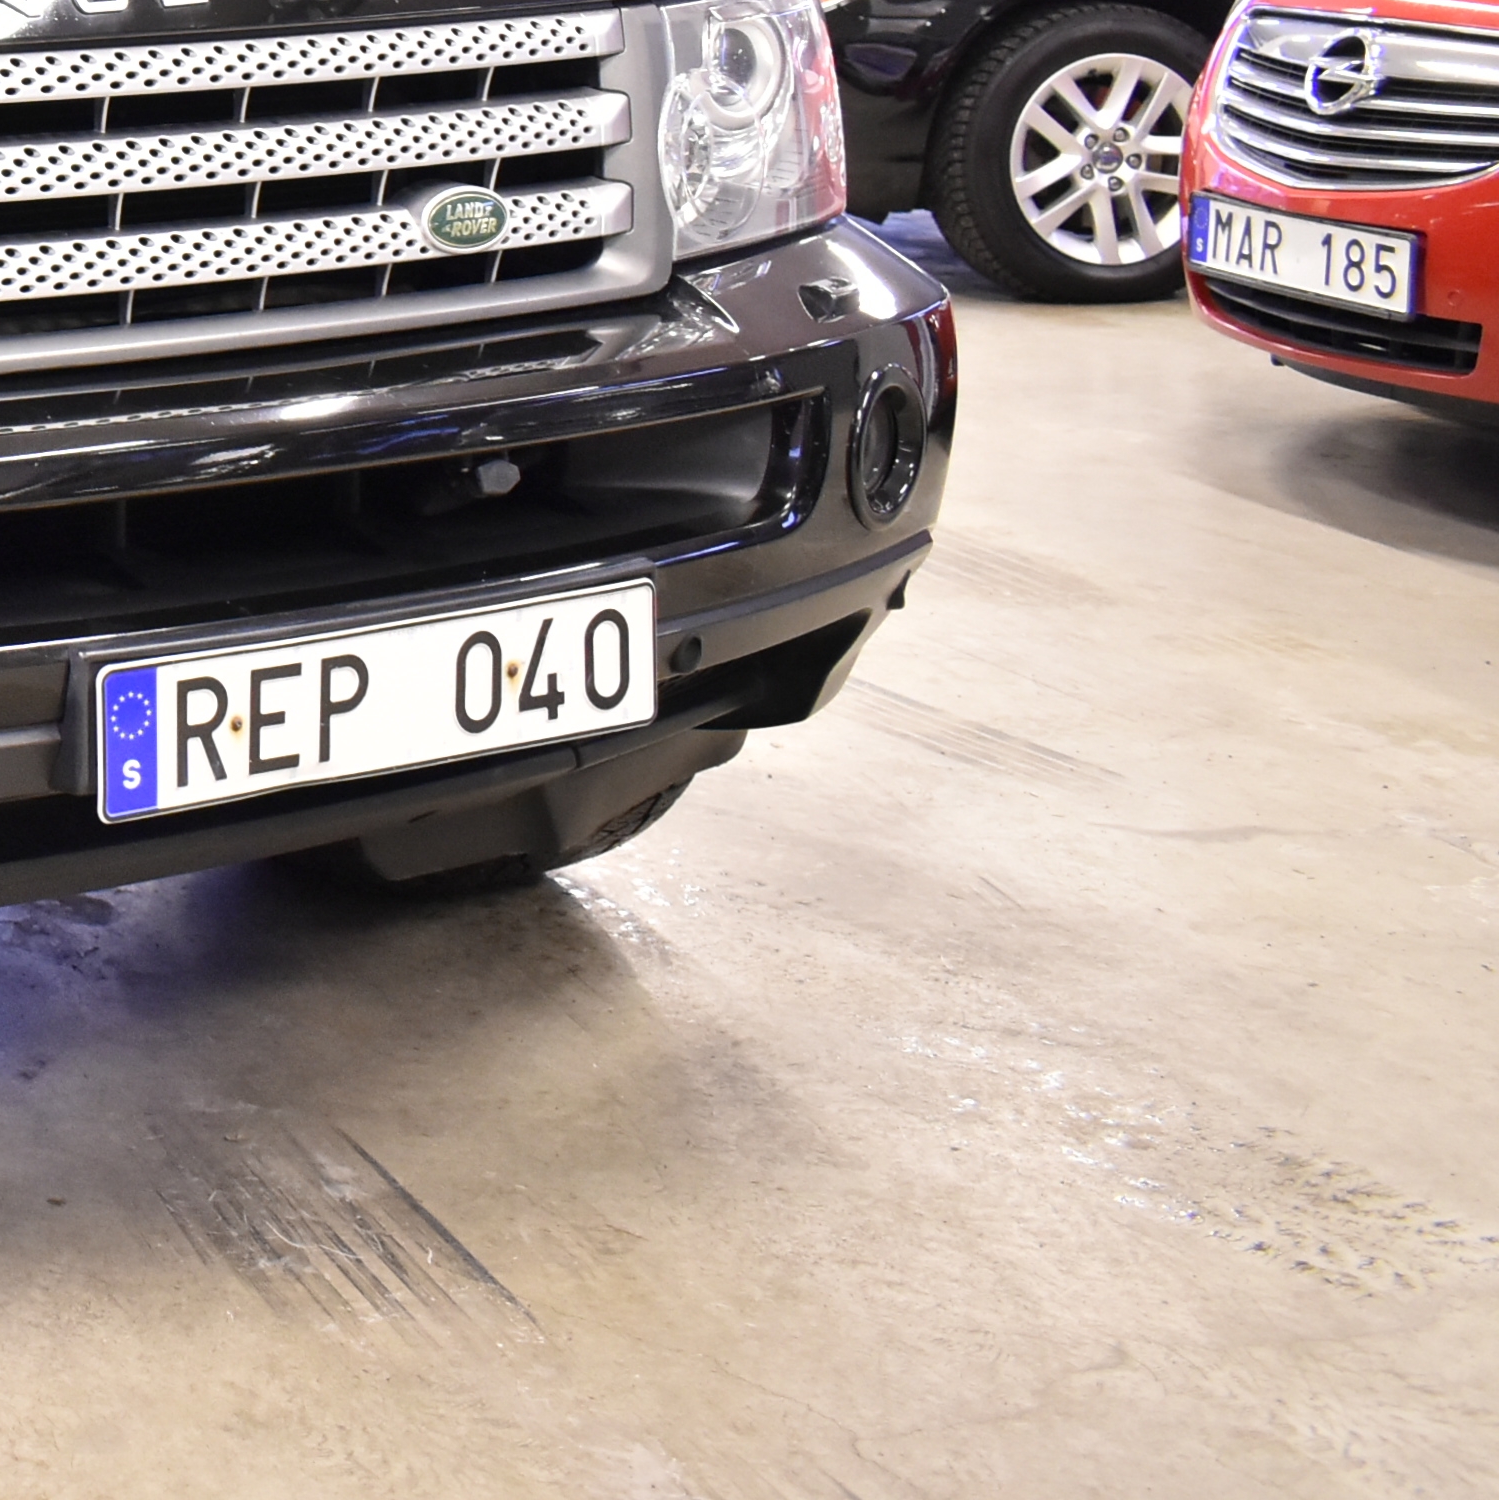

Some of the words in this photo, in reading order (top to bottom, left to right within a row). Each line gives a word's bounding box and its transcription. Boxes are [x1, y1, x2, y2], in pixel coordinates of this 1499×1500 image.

[445, 201, 484, 221] LAND
[450, 217, 498, 238] ROVER
[1195, 237, 1204, 253] S
[1211, 206, 1284, 276] MAR
[1320, 232, 1398, 300] 185
[175, 653, 371, 789] REP
[454, 608, 631, 735] 040
[121, 758, 142, 791] S
